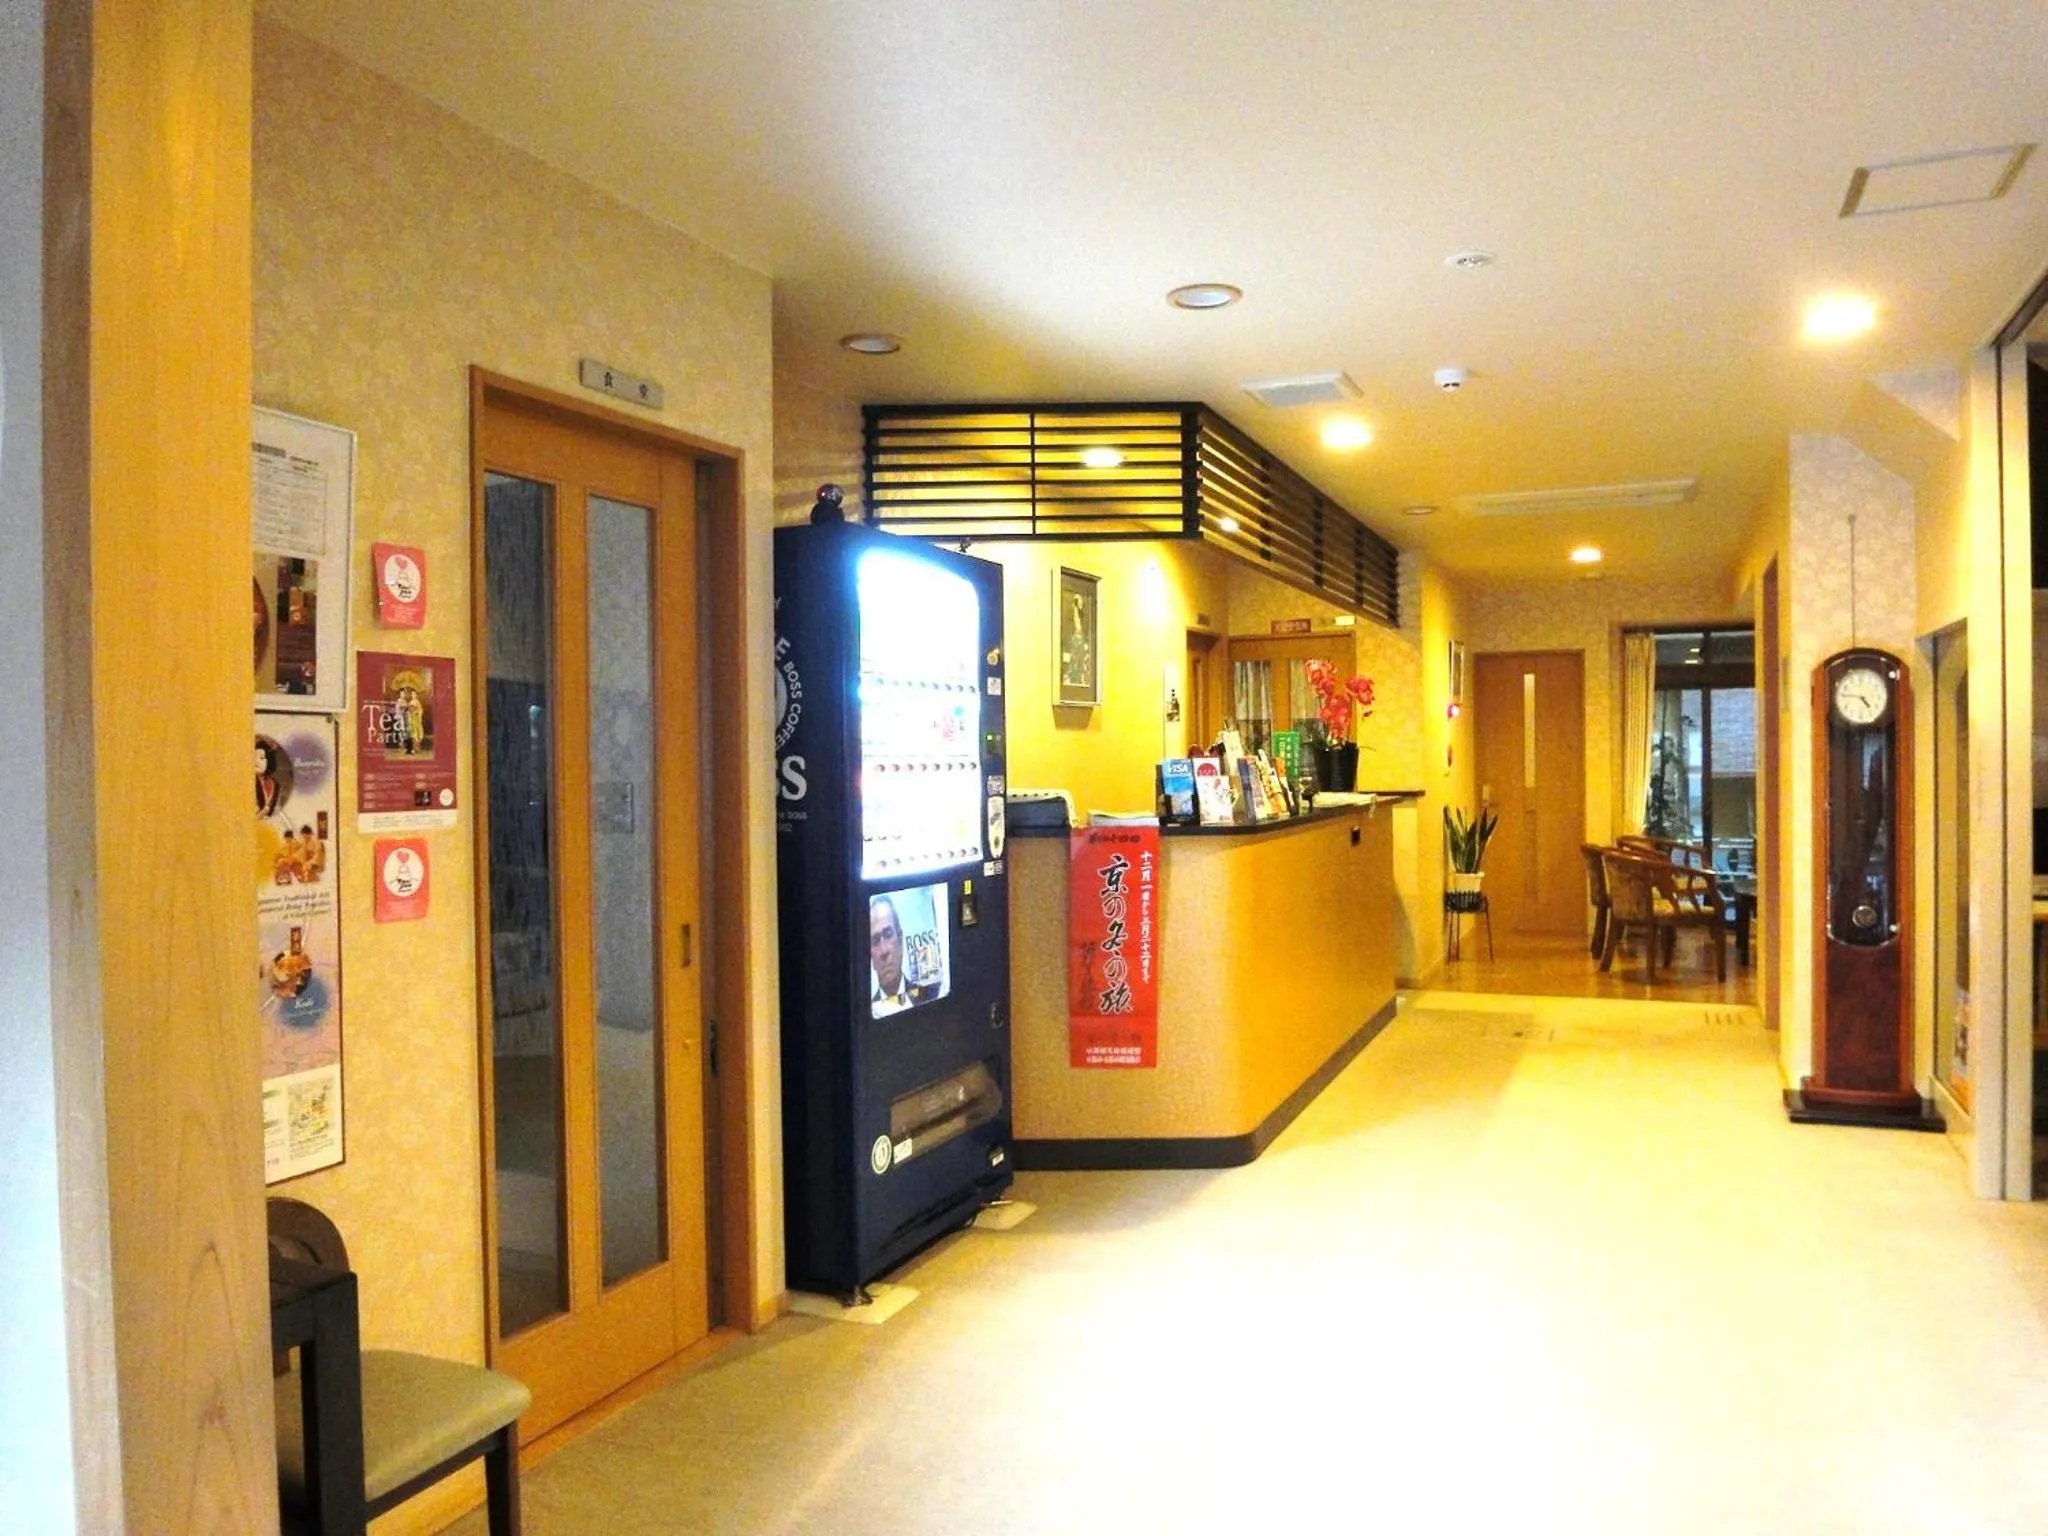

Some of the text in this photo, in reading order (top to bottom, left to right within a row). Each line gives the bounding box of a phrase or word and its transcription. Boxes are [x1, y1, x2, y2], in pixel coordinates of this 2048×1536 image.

[361, 704, 406, 732] Tea
[774, 661, 802, 750] BOSS COFFE
[367, 727, 408, 747] Party
[1167, 764, 1188, 774] VISA
[1097, 853, 1134, 1015] 京の冬の旅
